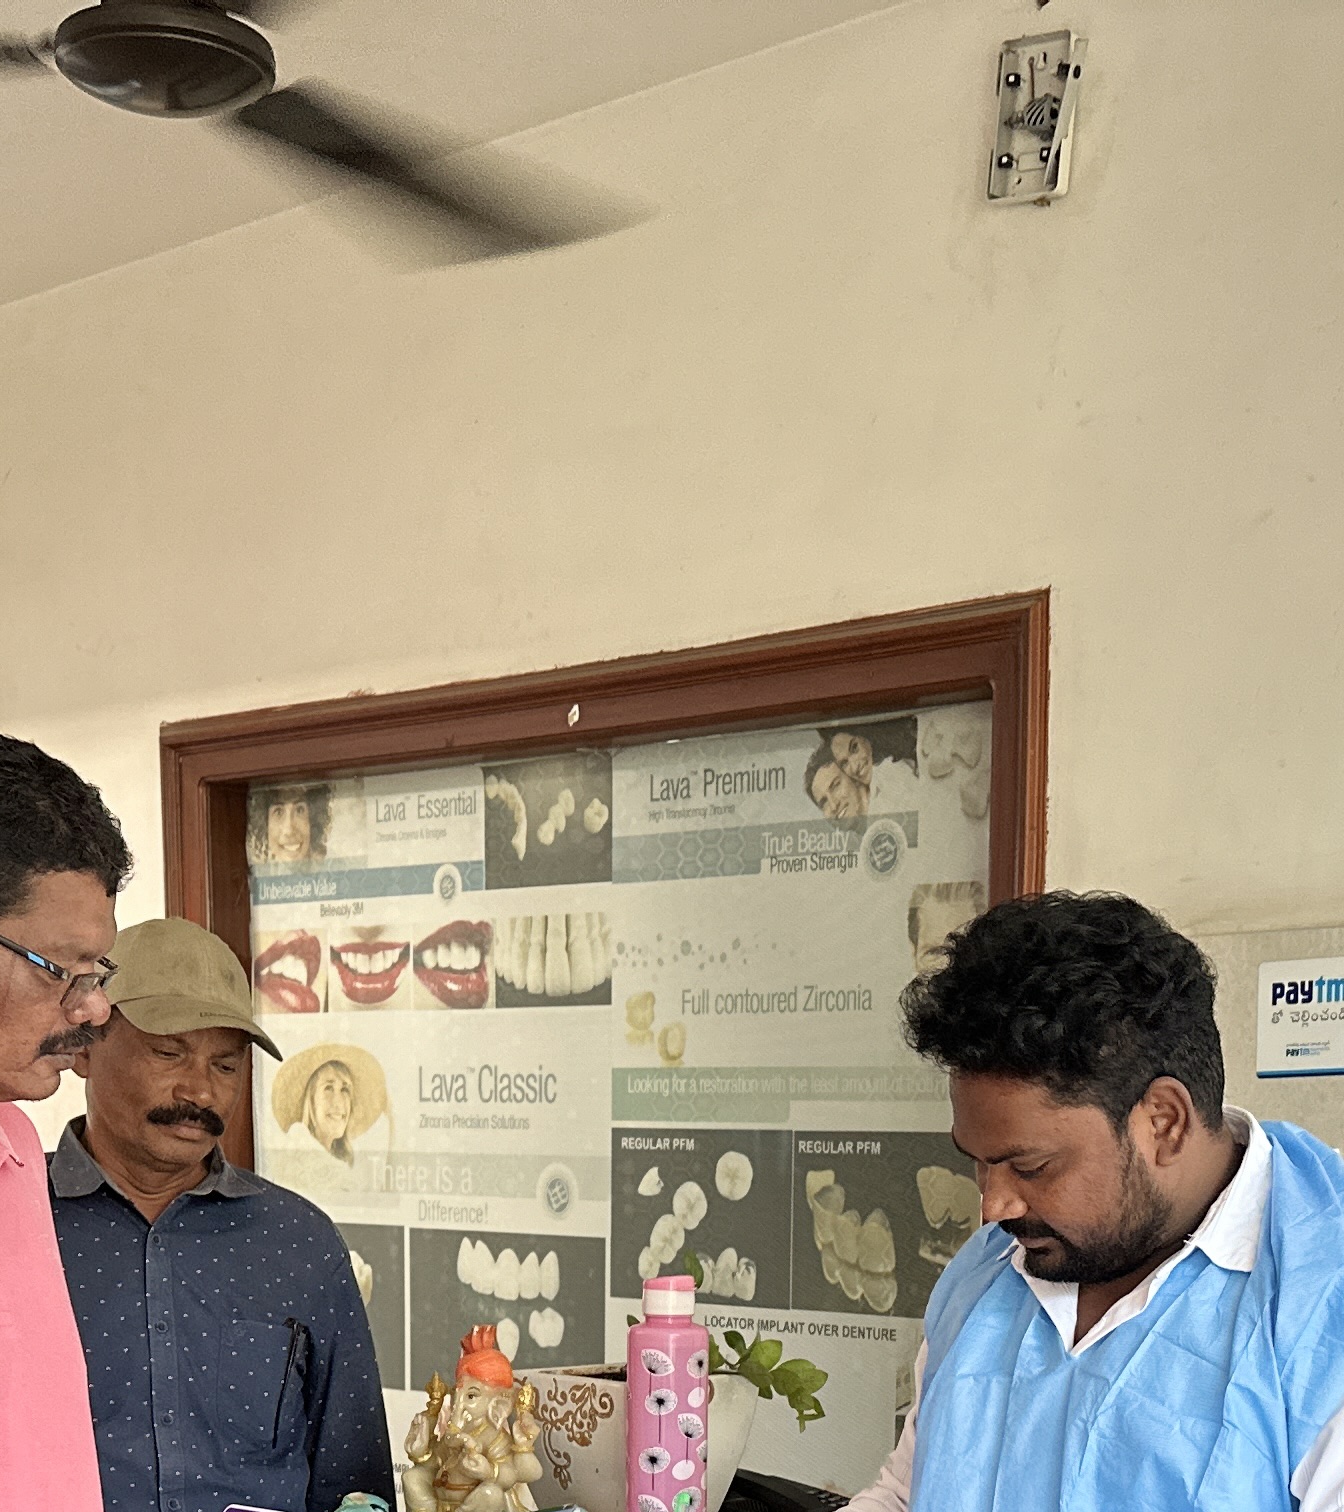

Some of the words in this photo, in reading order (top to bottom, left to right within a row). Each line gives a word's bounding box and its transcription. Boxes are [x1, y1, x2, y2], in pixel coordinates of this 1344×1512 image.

[704, 763, 786, 797] Premium
[417, 790, 477, 819] Essential
[762, 832, 793, 856] True
[798, 827, 850, 854] Beauty
[770, 855, 807, 874] Proven
[810, 851, 858, 874] Strength
[259, 880, 311, 900] Unbelievable
[312, 877, 337, 896] Value
[682, 989, 709, 1015] Full
[715, 985, 798, 1015] contoured
[802, 983, 872, 1012] Zirconia
[478, 1064, 557, 1104] Classic
[628, 1074, 669, 1097] Looking
[672, 1074, 687, 1093] for
[689, 1078, 697, 1093] a
[700, 1074, 754, 1094] restoration
[419, 1113, 451, 1129] Zirconia
[452, 1114, 490, 1129] Precision
[491, 1115, 530, 1130] Solutions
[621, 1137, 670, 1150] REGULAR
[672, 1138, 695, 1150] PFM
[798, 1140, 855, 1154] REGULAR
[857, 1141, 882, 1155] PFM
[368, 1155, 427, 1193] There
[436, 1157, 453, 1193] is
[461, 1166, 473, 1193] a
[418, 1199, 488, 1225] Difference!
[705, 1315, 754, 1331] LOCATOR
[757, 1318, 805, 1335] IMPLANT
[808, 1322, 839, 1338] OVER
[842, 1325, 897, 1342] DENTURE
